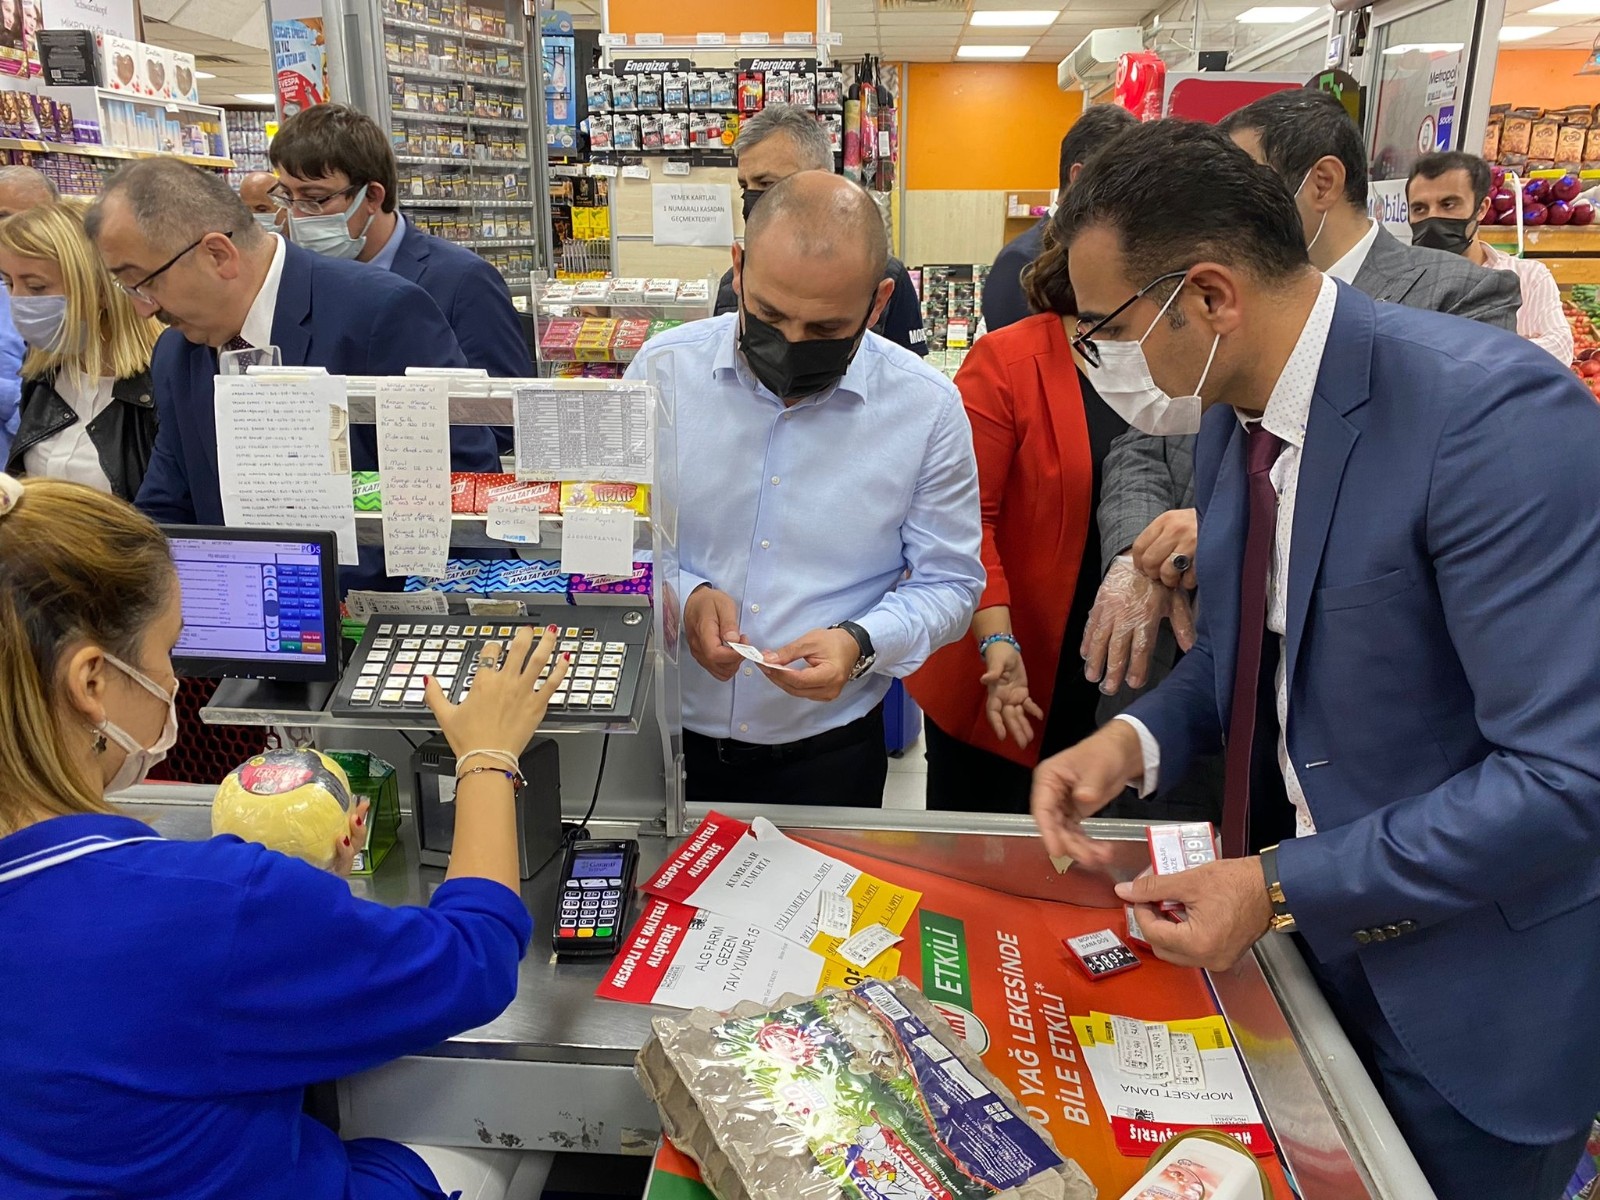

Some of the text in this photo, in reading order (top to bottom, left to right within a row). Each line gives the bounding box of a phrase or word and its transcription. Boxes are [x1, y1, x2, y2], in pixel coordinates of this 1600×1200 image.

[624, 60, 669, 73] Energizer
[750, 58, 795, 71] Energizer
[362, 483, 380, 493] KAT!
[517, 490, 532, 499] TAT
[531, 485, 549, 495] KAT!
[460, 568, 478, 578] KAT!
[510, 568, 560, 584] ANA TAT KAT!
[653, 821, 720, 890] HESAPLI VE KALİTELİ
[687, 842, 725, 878] ALIŞVERİŞ
[725, 851, 760, 888] KUMBASAR
[740, 857, 771, 889] YUMURTA
[640, 900, 670, 937] KALİTELİ
[785, 888, 811, 916] YUMURTA
[633, 937, 650, 950] VE
[646, 923, 682, 968] ALIŞVERİŞ
[695, 925, 725, 972] ALG FARM
[716, 935, 739, 966] GEZEN
[925, 925, 963, 995] ETKİLİ
[611, 950, 643, 989] HESAPLI
[997, 930, 1036, 1045] LEKESİNDE
[1008, 1047, 1045, 1097] YAĞ
[1055, 1065, 1090, 1126] BİLE
[1120, 1083, 1234, 1101] MOPASET DANA
[896, 1144, 946, 1198] YUMURTA
